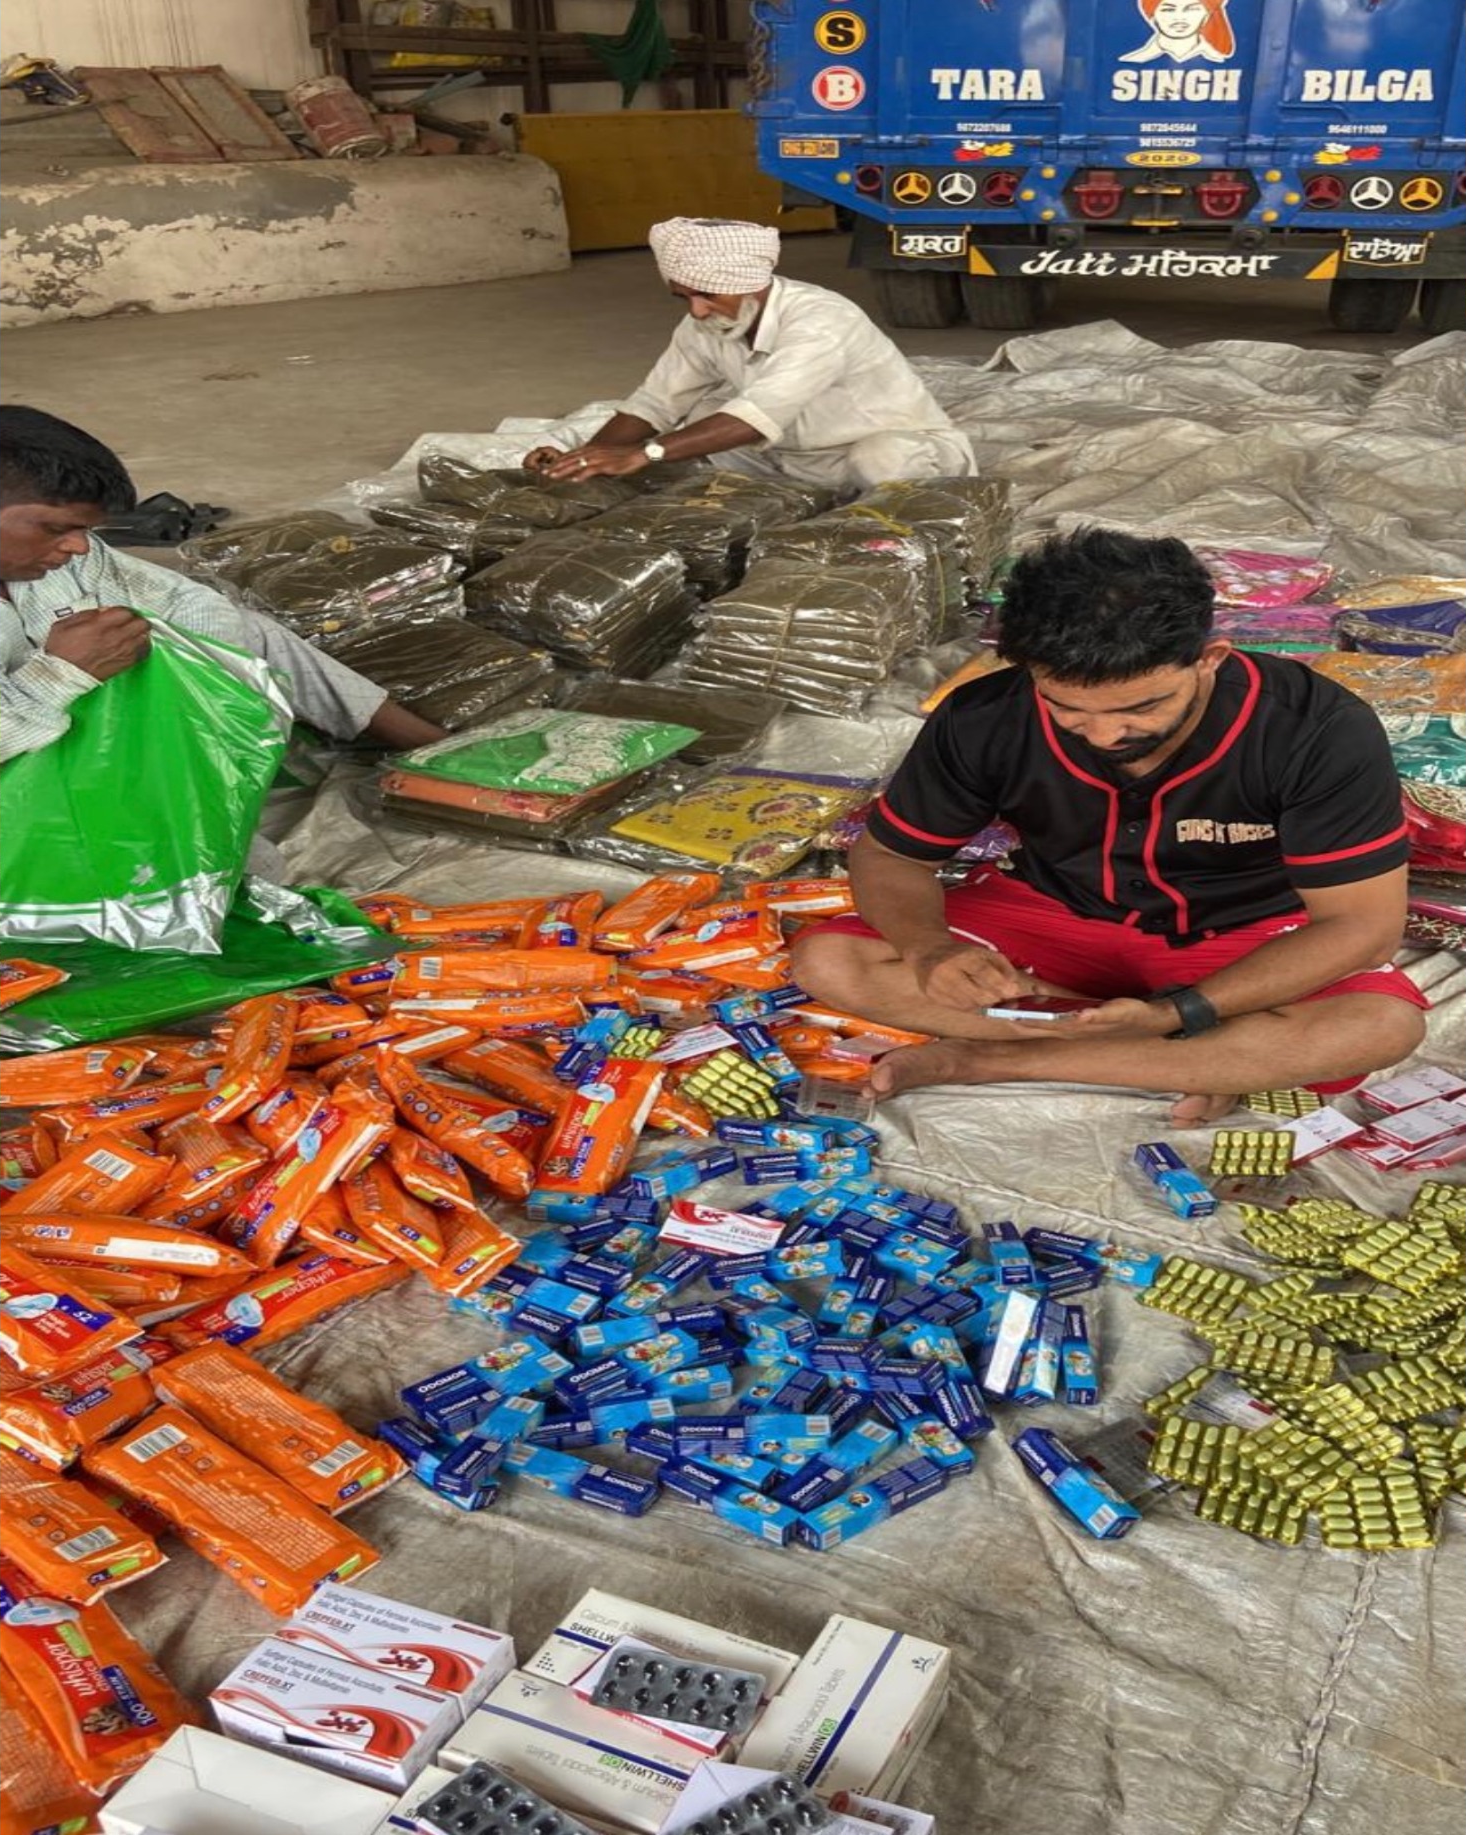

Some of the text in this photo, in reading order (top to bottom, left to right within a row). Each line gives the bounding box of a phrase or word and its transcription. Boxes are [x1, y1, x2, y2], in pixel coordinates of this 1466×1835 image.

[826, 17, 856, 48] S
[825, 73, 856, 103] B
[931, 69, 1434, 101] TARA SINGH BILGA
[1139, 153, 1189, 163] 2020
[1020, 249, 1117, 277] Jatt
[1176, 818, 1214, 842] GUNS
[1228, 822, 1276, 844] ROSES
[562, 1106, 584, 1150] whisper
[1040, 1231, 1086, 1247] ODOMOS
[280, 1267, 336, 1303] whisper
[519, 1311, 561, 1333] ODOMOS
[72, 1360, 116, 1387] whisper
[418, 1369, 468, 1394] ODOMOS
[570, 1359, 619, 1384] ODOMOS
[937, 1388, 958, 1428] ODOMOS
[679, 1425, 724, 1434] ODOMOS
[605, 1474, 645, 1494] ODOMOS
[791, 1476, 824, 1500] ODOMOS
[580, 1608, 621, 1630] Calcium
[570, 1622, 615, 1645] SHELLW
[47, 1641, 97, 1698] whisper
[83, 1660, 111, 1692] choice
[287, 1656, 316, 1672] Capsules
[796, 1735, 828, 1779] HELLWIN
[621, 1757, 685, 1792] SHELLWIN
